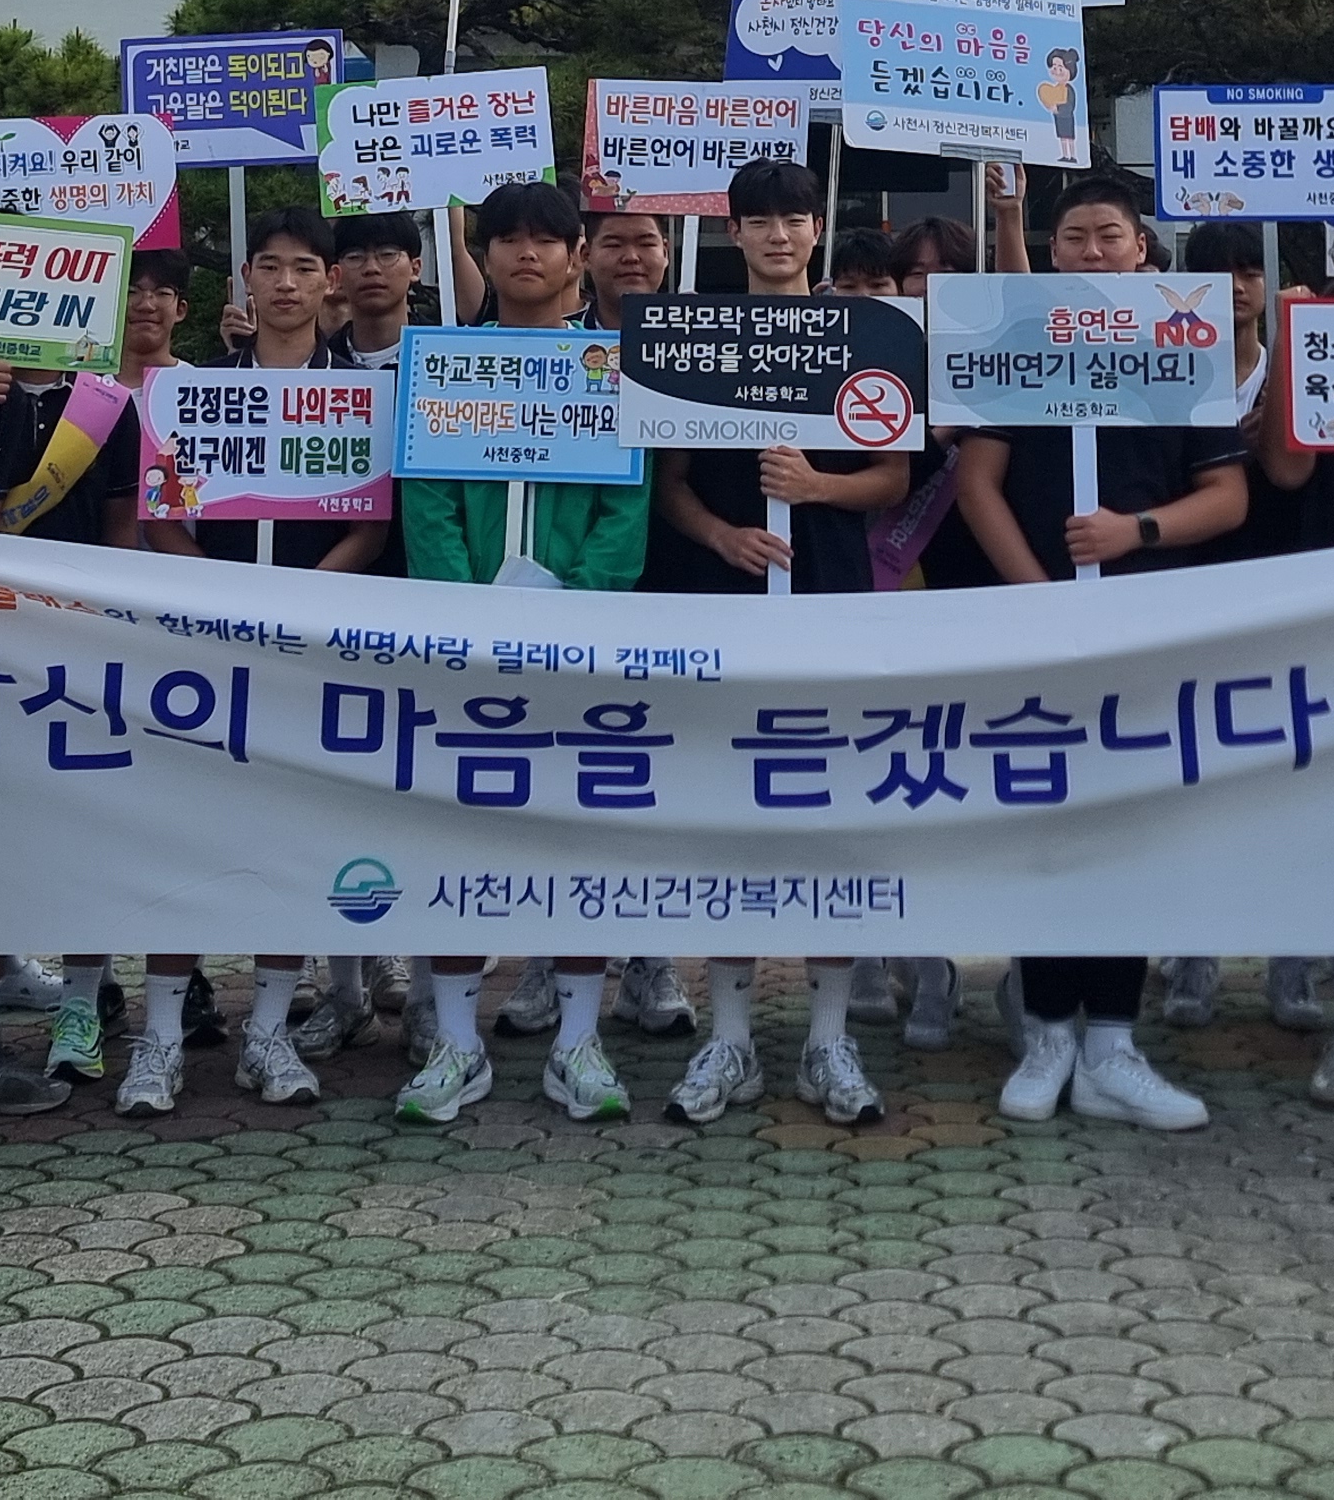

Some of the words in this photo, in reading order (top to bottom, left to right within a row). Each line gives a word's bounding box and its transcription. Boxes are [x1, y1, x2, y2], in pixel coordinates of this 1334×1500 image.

[747, 16, 785, 36] 사천시
[857, 17, 944, 53] 당신의
[955, 22, 1032, 66] 마음을
[146, 56, 223, 86] 거친말은
[227, 51, 305, 81] 독이되고
[869, 61, 1025, 108] 듣겠습니다.
[146, 90, 224, 121] 고운말은
[228, 87, 308, 118] 덕이된다
[352, 102, 401, 127] 나만
[407, 95, 479, 123] 즐거운
[487, 90, 536, 116] 장난
[606, 94, 698, 125] 바른마음
[705, 98, 798, 128] 바른언어
[1226, 88, 1249, 101] NO
[1253, 87, 1304, 101] SMOKING
[354, 136, 402, 165] 남은
[410, 130, 483, 159] 괴로운
[490, 126, 538, 152] 폭력
[892, 115, 930, 134] 사천시
[933, 120, 1028, 143] 정신건강복지센터
[1170, 115, 1242, 142] 담배와
[60, 148, 99, 175] 우리
[105, 145, 143, 172] 같이
[603, 137, 696, 168] 바른언어
[1171, 150, 1196, 180] 내
[1213, 150, 1296, 180] 소중한
[48, 183, 109, 210] 생명의
[115, 180, 155, 206] 가치
[44, 246, 117, 284] OUT
[52, 293, 96, 329] IN
[640, 305, 744, 337] 모락모락
[750, 305, 849, 337] 담배연기
[1045, 308, 1140, 344] 흡연은
[1154, 321, 1218, 349] NO
[424, 353, 574, 392] 학교폭력예방
[641, 342, 743, 373] 내생명을
[748, 343, 852, 374] 앗아간다
[946, 351, 1077, 390] 담배연기
[1086, 351, 1195, 390] 싫어요!
[176, 385, 270, 427] 감정담은
[281, 385, 373, 426] 나의주먹
[734, 385, 809, 402] 사천중학교
[1045, 402, 1119, 418] 사천중학교
[520, 401, 556, 437] 나는
[639, 419, 677, 440] NO
[684, 418, 799, 441] SMOKING
[174, 435, 267, 476] 친구에겐
[279, 436, 372, 477] 마음의병
[482, 446, 551, 464] 사천중학교
[318, 497, 373, 513] 사천중학교
[156, 612, 310, 656] 함께하는
[326, 625, 473, 673] 생명사랑
[492, 638, 597, 676] 릴레이
[615, 645, 723, 684] 캠페인
[320, 680, 675, 809] 마음을
[730, 664, 1331, 811] 듣겠습니다
[427, 873, 555, 918] 사천시
[568, 872, 907, 921] 정신건강복지센터
